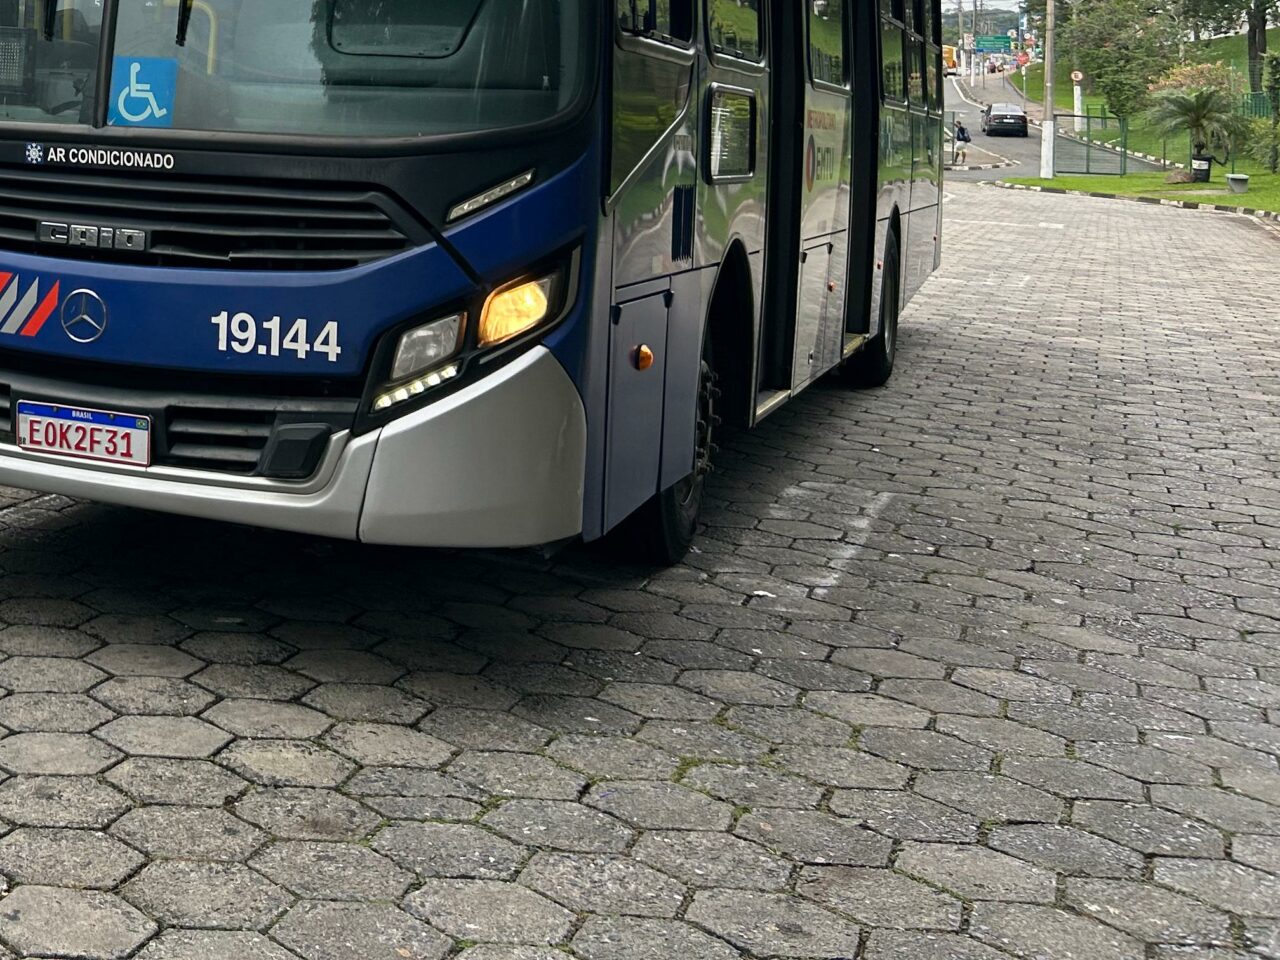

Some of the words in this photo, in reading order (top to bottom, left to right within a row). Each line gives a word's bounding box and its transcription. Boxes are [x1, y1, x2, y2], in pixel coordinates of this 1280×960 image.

[47, 147, 66, 163] AR
[69, 148, 174, 169] CONDICIONADO
[211, 311, 342, 362] 19.144
[71, 410, 93, 420] BRASIL
